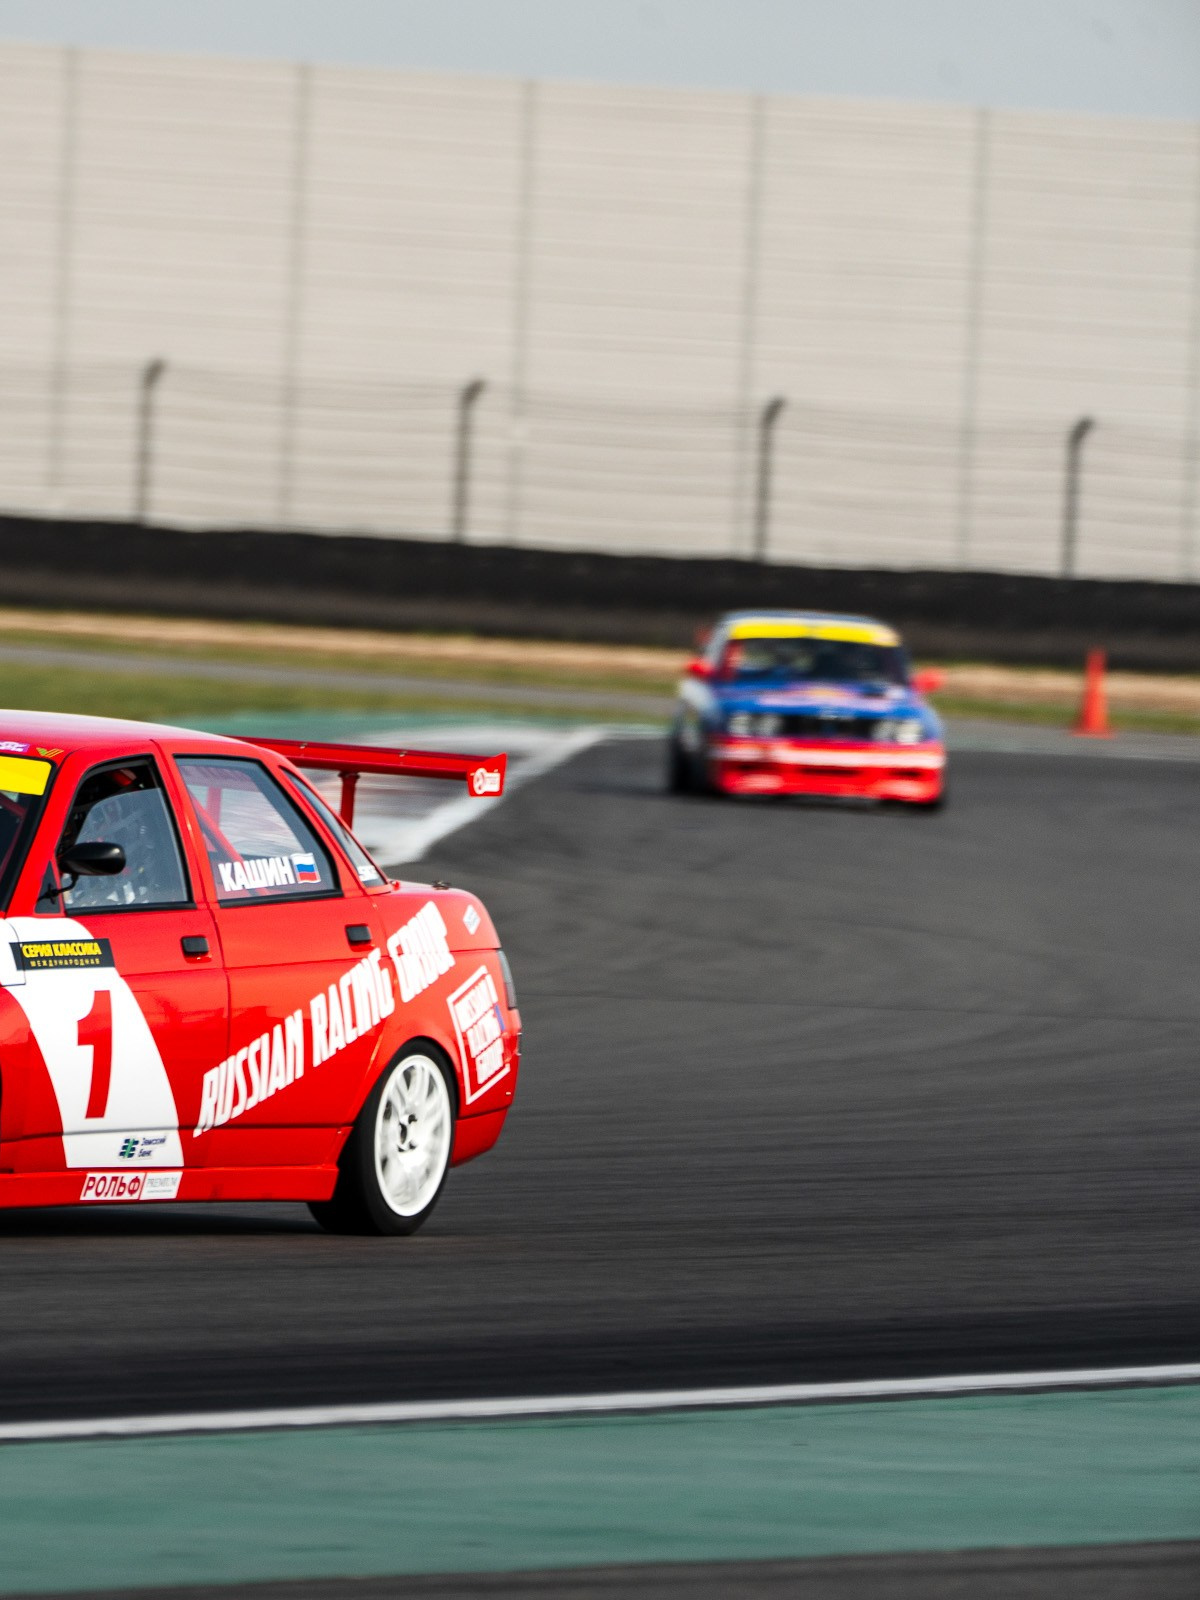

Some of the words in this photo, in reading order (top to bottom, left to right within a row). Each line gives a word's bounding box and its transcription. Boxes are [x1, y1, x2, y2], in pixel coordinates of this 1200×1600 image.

[218, 856, 296, 892] КАШИН
[22, 943, 54, 958] СЕРИЯ
[52, 942, 102, 956] КЛАССИКА
[193, 1008, 305, 1138] RUSSIAN
[309, 947, 395, 1067] RACING
[387, 900, 456, 1003] GROUP
[77, 989, 113, 1119] 1
[83, 1175, 141, 1197] РОЛЬФ
